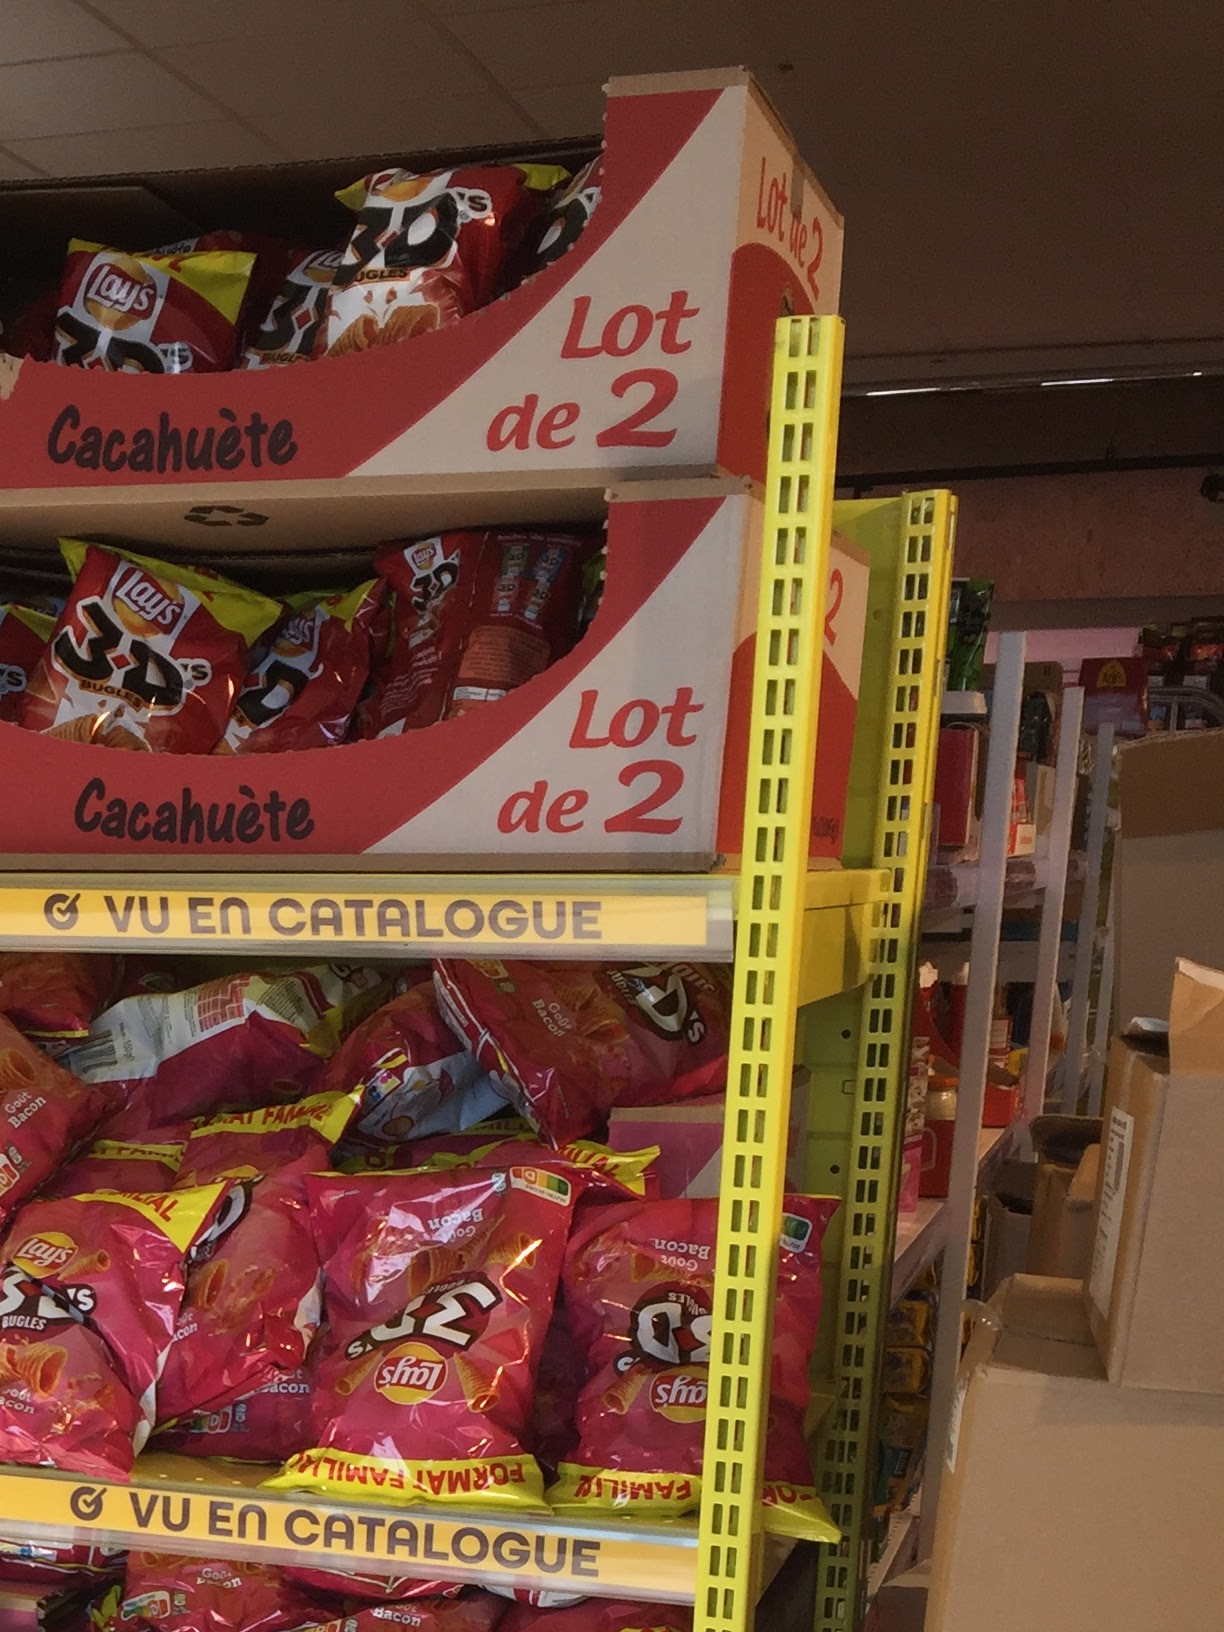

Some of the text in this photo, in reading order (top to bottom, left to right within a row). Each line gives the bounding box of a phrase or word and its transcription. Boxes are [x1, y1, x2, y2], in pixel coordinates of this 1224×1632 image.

[757, 157, 787, 235] Lot
[809, 218, 823, 293] 2
[88, 263, 157, 314] Lay's
[561, 290, 699, 359] Lot
[486, 369, 678, 451] de 2
[47, 406, 298, 474] Cacahuète
[120, 573, 181, 624] Lay's
[569, 687, 703, 748] Lot
[75, 777, 314, 844] Cacahuète
[497, 760, 683, 833] de 2
[104, 898, 601, 939] VU EN CATALOGUE
[531, 1000, 566, 1036] Bacon
[4, 1091, 31, 1114] Goût
[8, 1094, 47, 1129] Bacon
[428, 1210, 484, 1232] Bacon
[19, 1237, 73, 1269] Lay's
[654, 1238, 711, 1260] Bacon
[382, 1362, 442, 1384] Lay's
[438, 1463, 523, 1494] FORMAT
[130, 1493, 599, 1577] VU EN CATALOGUE
